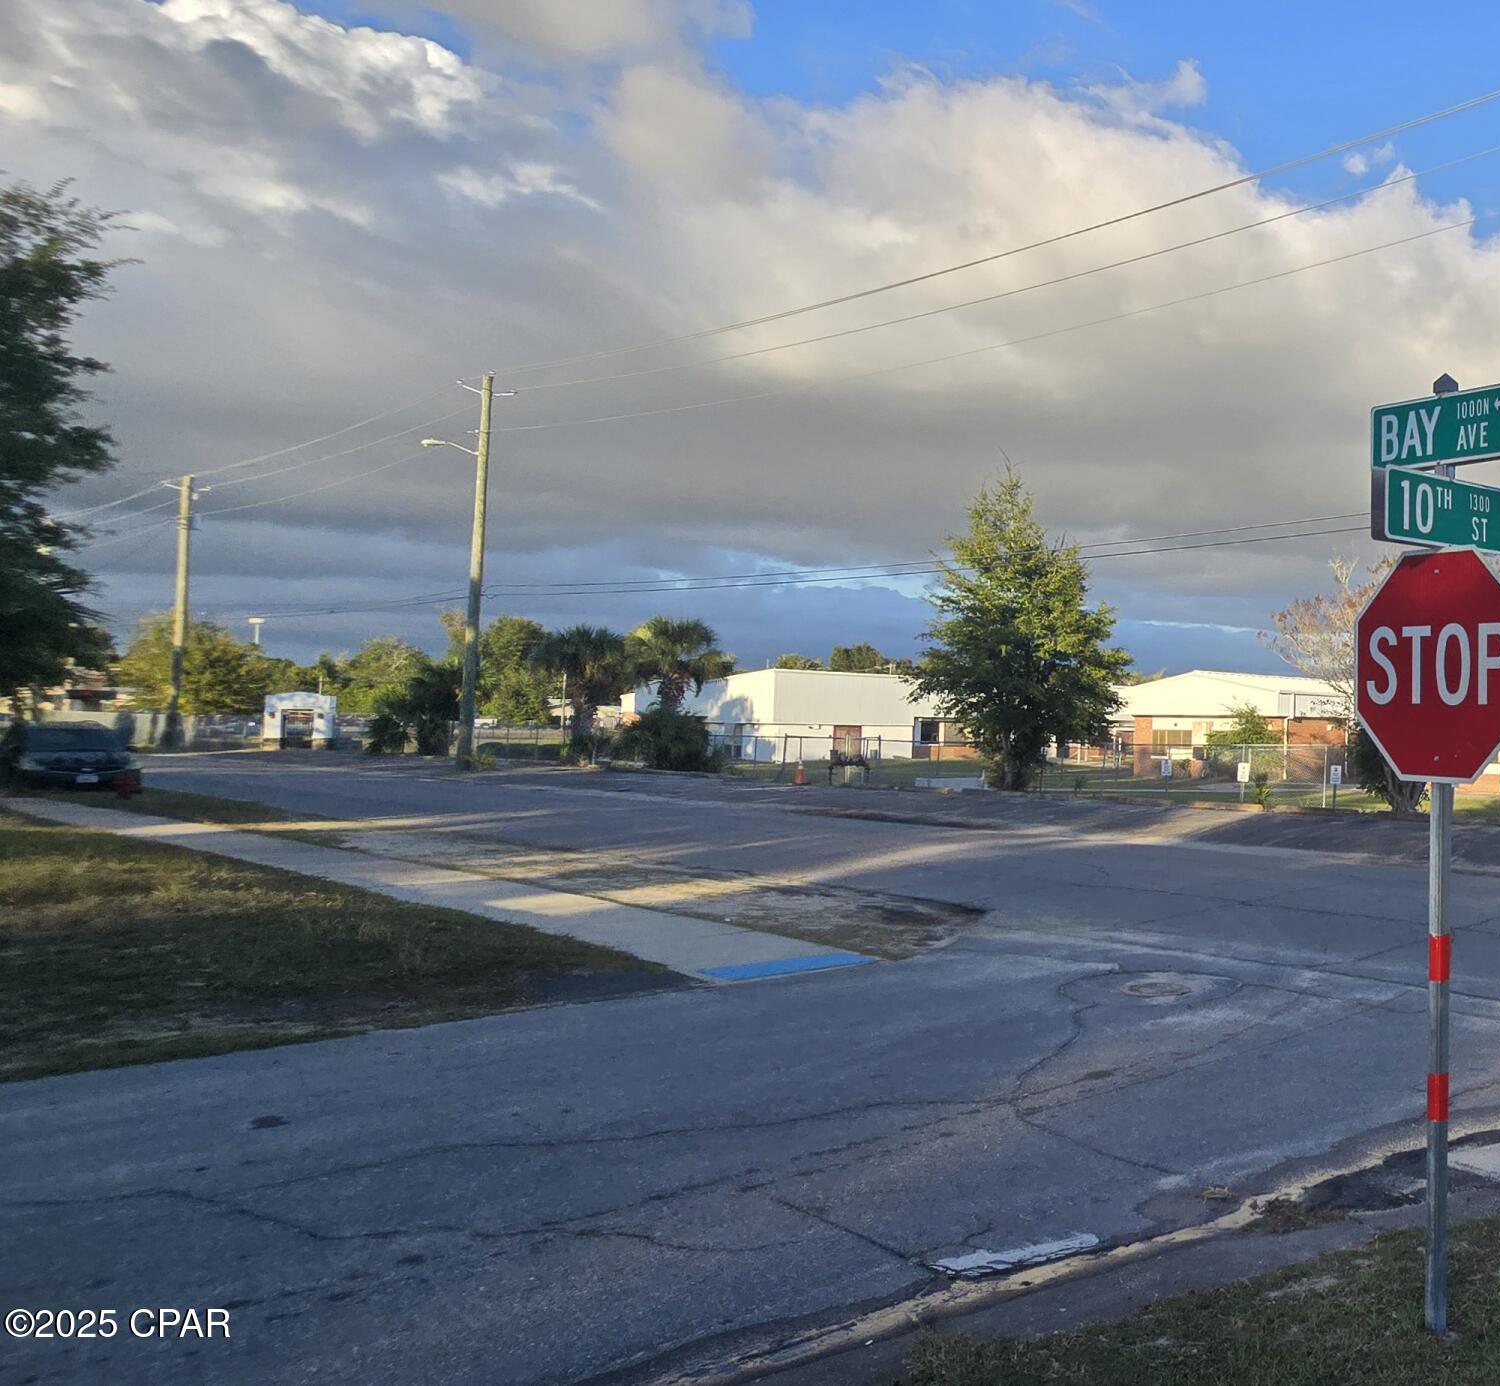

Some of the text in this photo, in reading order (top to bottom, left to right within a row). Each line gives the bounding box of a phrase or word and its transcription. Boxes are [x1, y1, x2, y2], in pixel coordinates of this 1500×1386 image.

[1456, 398, 1490, 420] 1000N
[1380, 406, 1489, 463] BAY AVE
[1400, 479, 1453, 534] 10TH
[1469, 492, 1491, 513] 1300
[1471, 516, 1488, 543] ST
